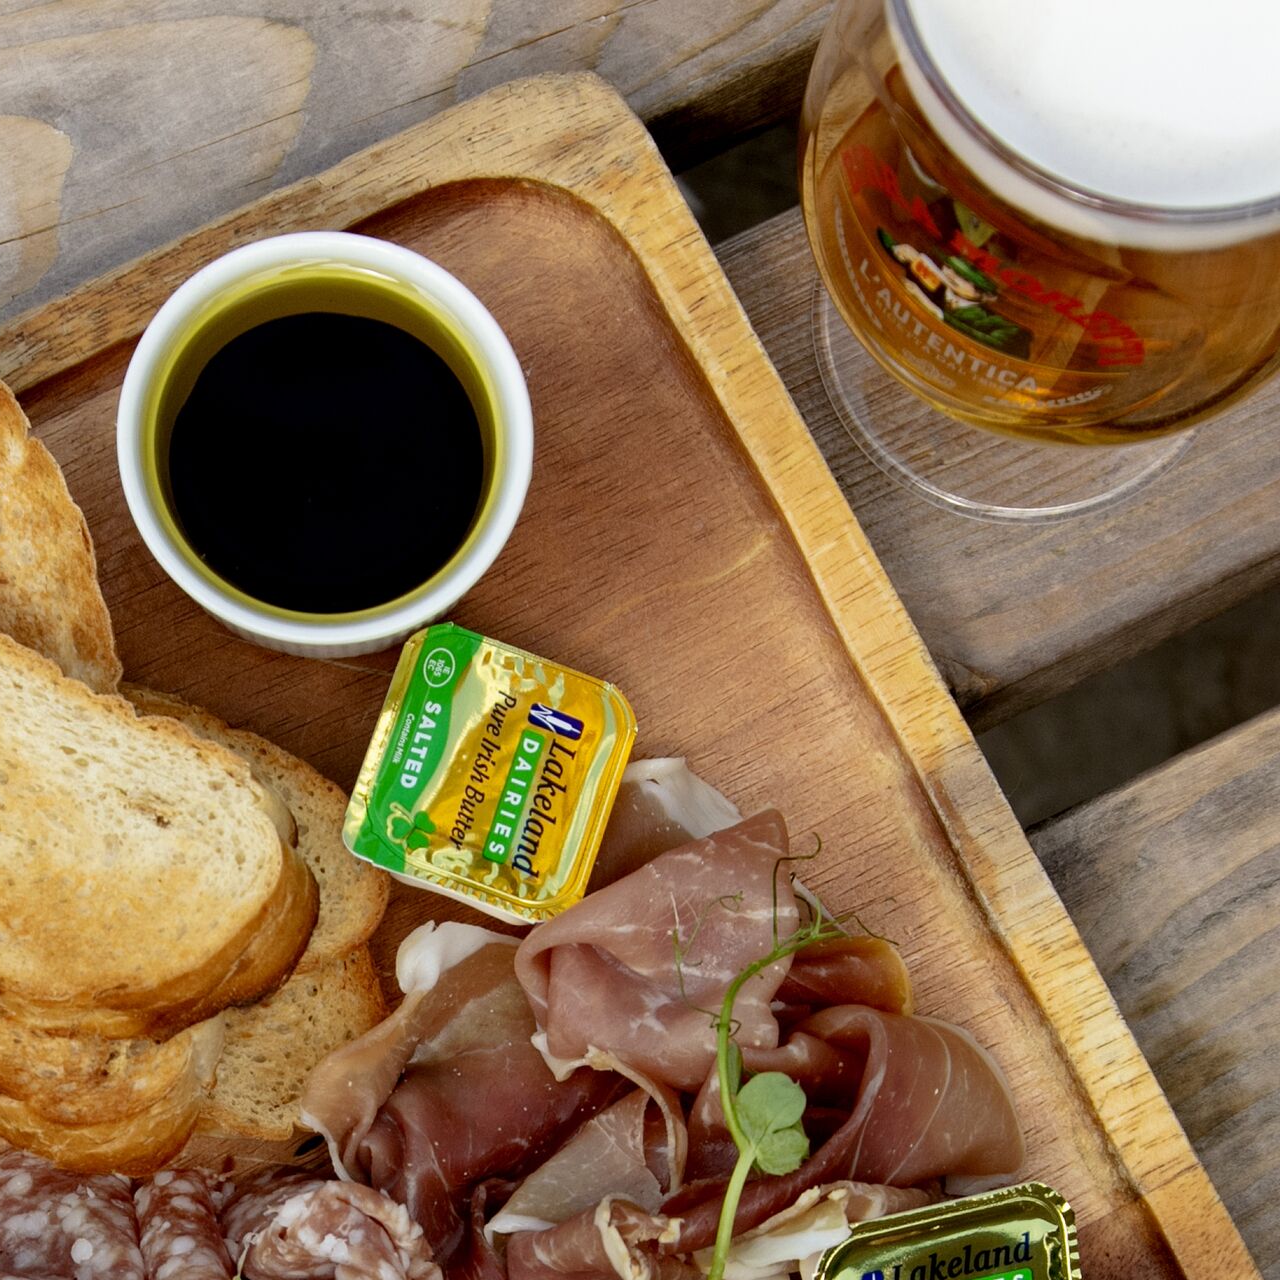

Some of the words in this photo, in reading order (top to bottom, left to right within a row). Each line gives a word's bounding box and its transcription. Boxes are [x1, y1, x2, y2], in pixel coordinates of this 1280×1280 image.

[398, 713, 415, 747] Contains
[485, 690, 517, 738] Pure
[392, 747, 404, 763] Milk
[400, 700, 442, 789] SALTED
[472, 736, 502, 785] Irish
[448, 784, 486, 852] Butter
[488, 738, 540, 856] DAIRIES
[511, 739, 576, 879] Lakeland
